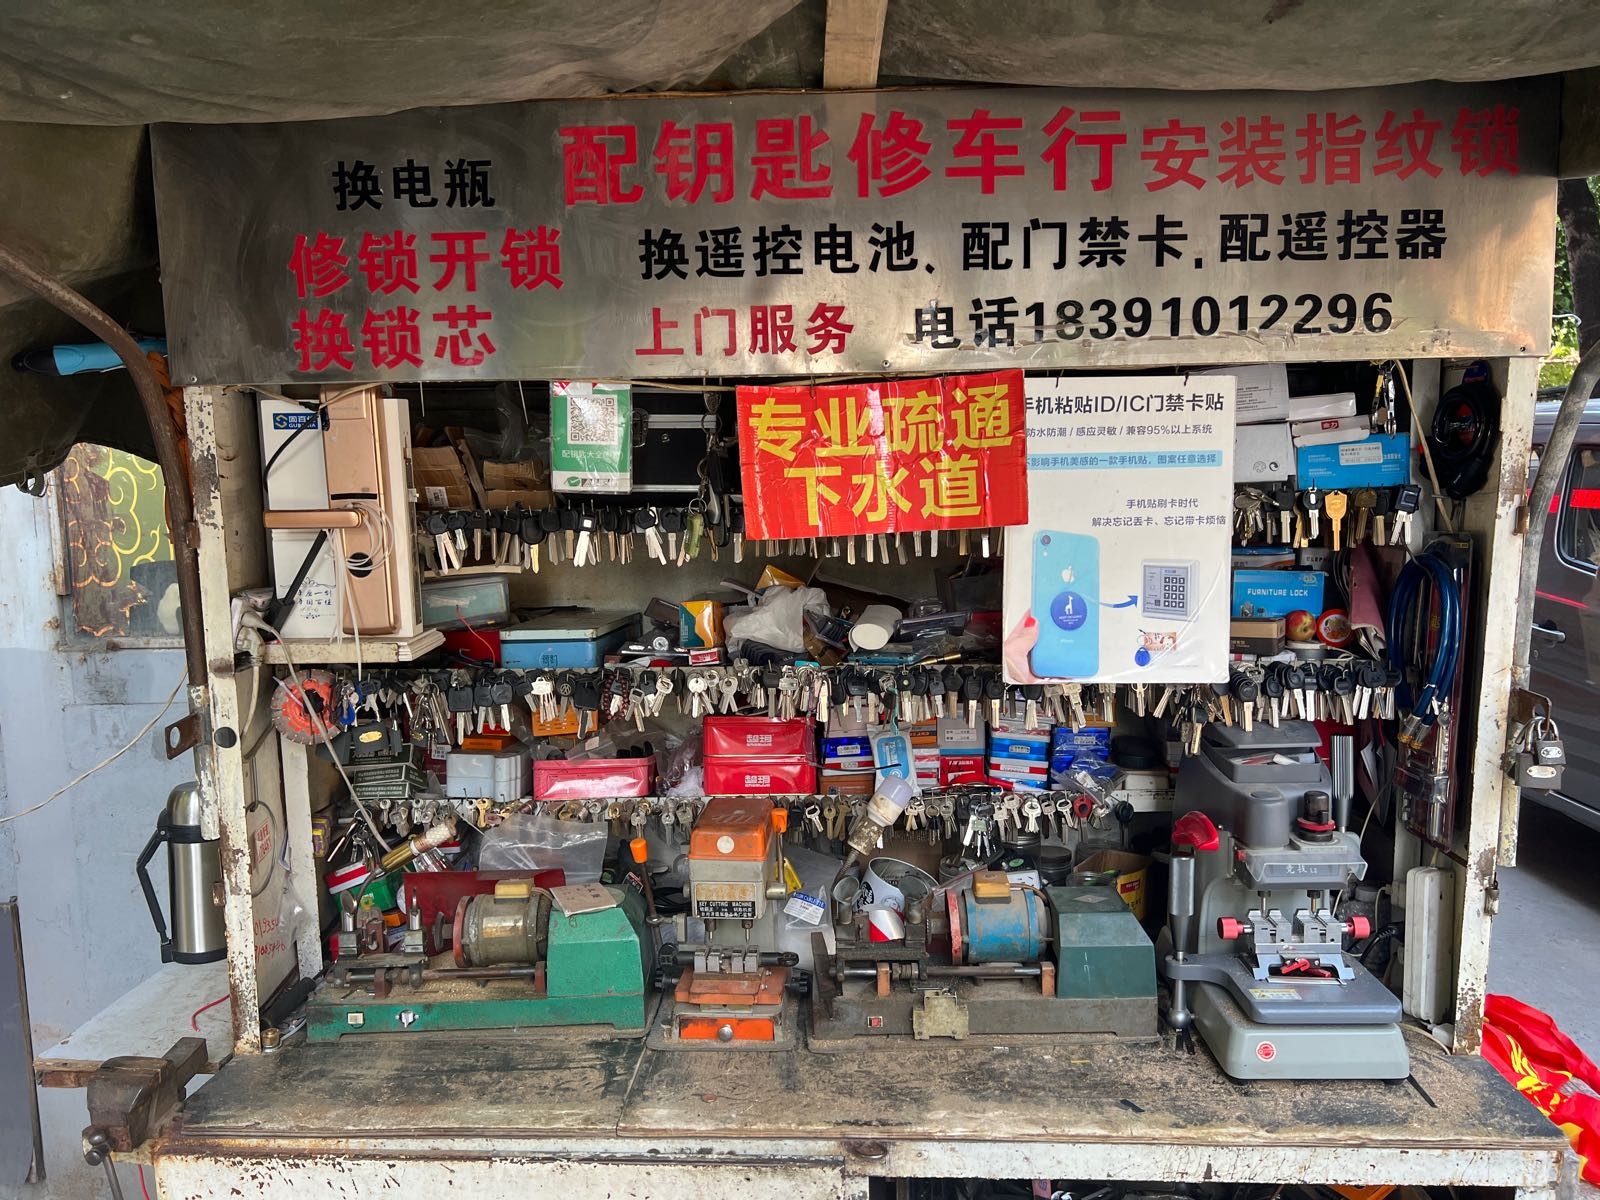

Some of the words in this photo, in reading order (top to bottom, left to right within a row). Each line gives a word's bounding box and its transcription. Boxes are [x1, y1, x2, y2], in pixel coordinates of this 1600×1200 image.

[332, 157, 496, 212] 换电瓶
[288, 224, 564, 299] 修锁开锁
[291, 304, 497, 372] 换锁芯
[636, 302, 854, 356] 上门服务
[914, 292, 1393, 350] 电话18391012296
[749, 383, 1014, 462] 专业疏通
[1075, 426, 1117, 437] 感应灵敏
[1126, 424, 1213, 436] 兼容95%以上系统
[784, 453, 982, 526] 下水道
[1126, 498, 1199, 509] 手机贴刷卡时代
[1091, 515, 1226, 527] 解决忘记丢卡、忘记带卡烦恼
[1247, 588, 1287, 596] FURNITURE
[1289, 589, 1309, 597] LOCK
